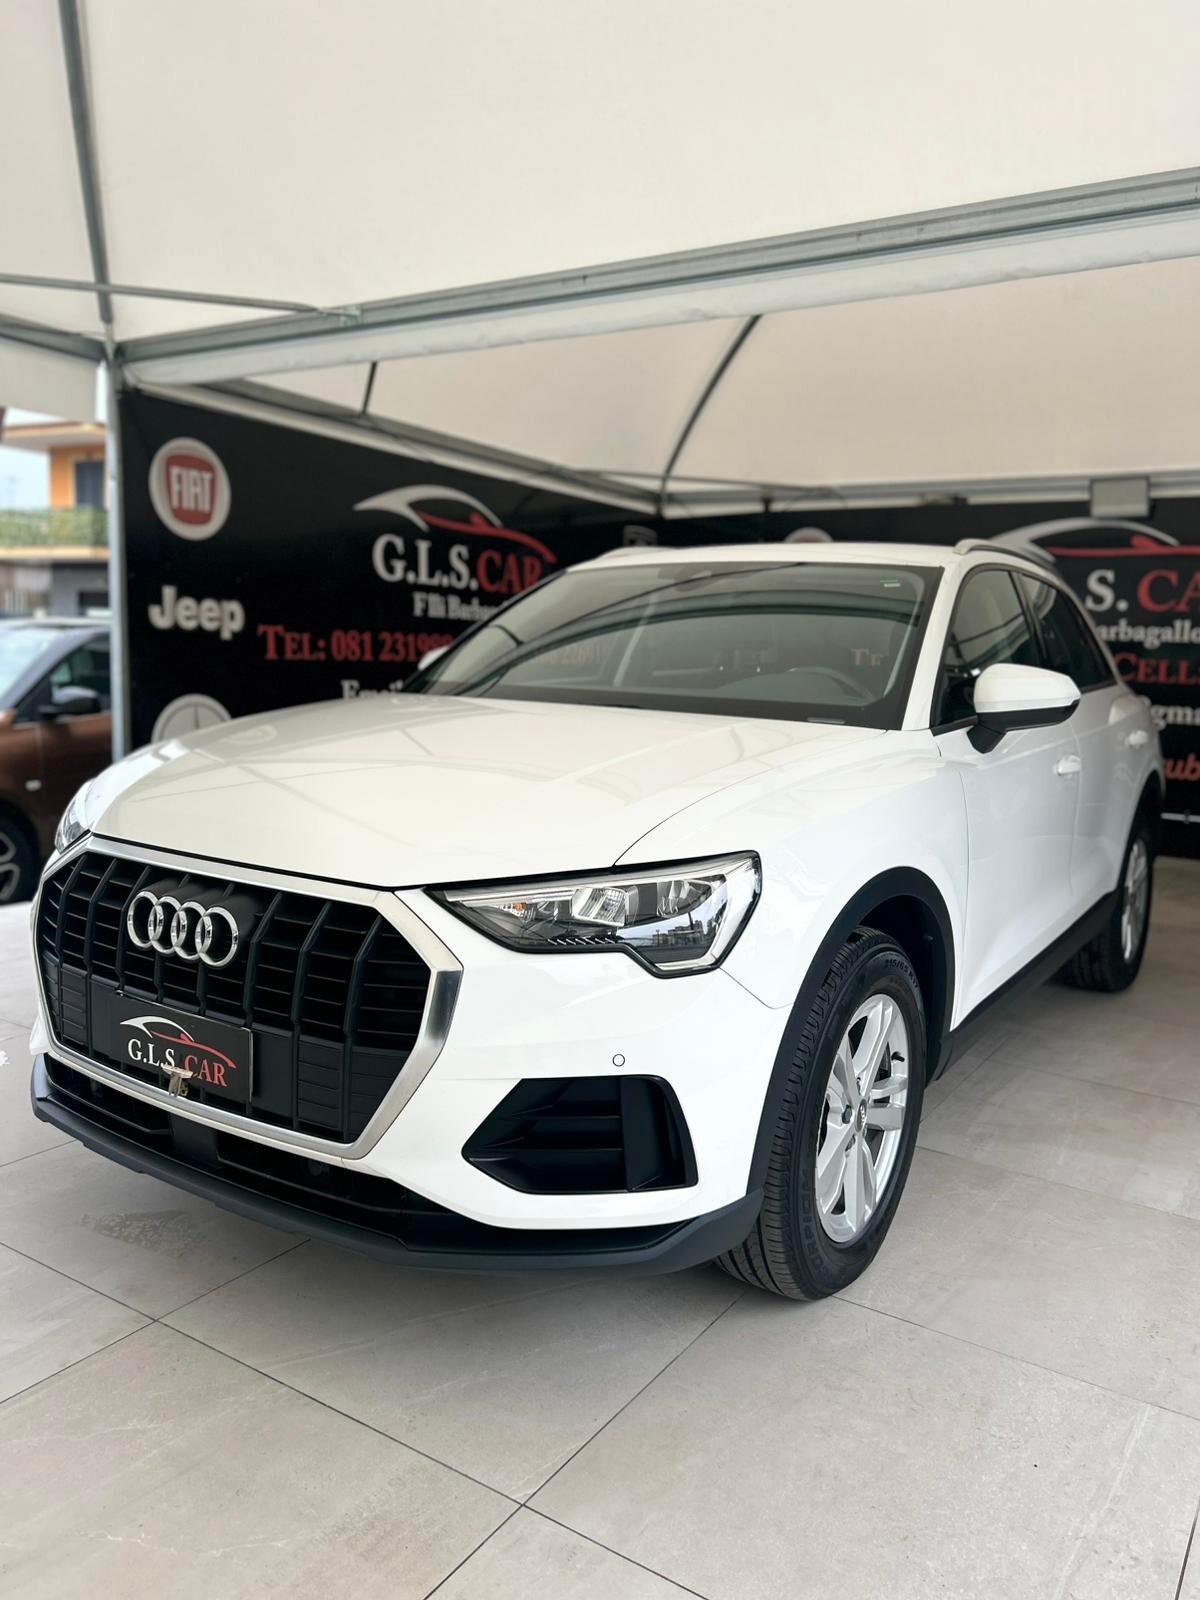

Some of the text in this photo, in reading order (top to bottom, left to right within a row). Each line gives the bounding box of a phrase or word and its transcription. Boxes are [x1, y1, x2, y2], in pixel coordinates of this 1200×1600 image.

[170, 465, 214, 515] FIAT
[148, 585, 245, 640] Jeep
[256, 624, 327, 661] TEL:
[331, 629, 374, 662] 081
[183, 1054, 228, 1088] CAR
